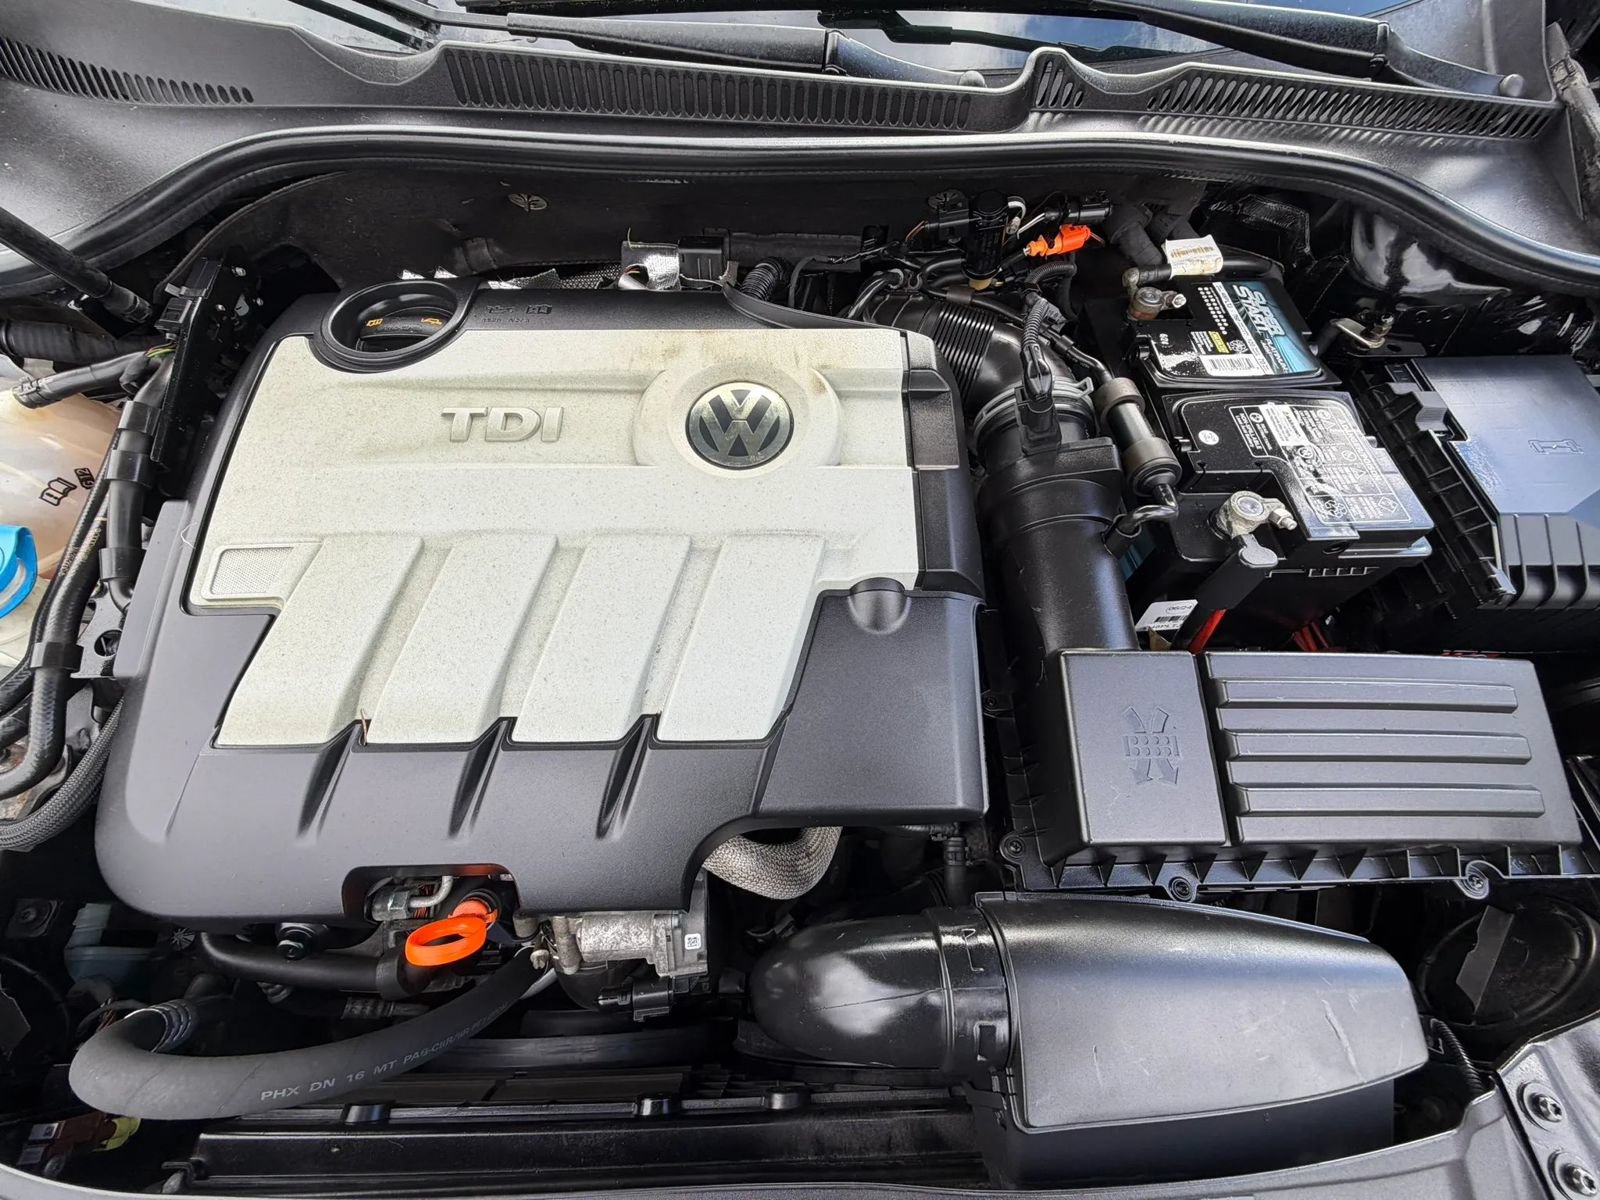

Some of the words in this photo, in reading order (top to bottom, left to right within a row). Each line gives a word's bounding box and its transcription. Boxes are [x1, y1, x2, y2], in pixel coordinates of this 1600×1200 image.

[1232, 285, 1267, 337] START
[1252, 290, 1286, 337] SUPER
[440, 406, 564, 443] TDI
[685, 380, 795, 471] VW
[261, 1086, 300, 1101] PHX
[309, 1078, 336, 1092] DN
[346, 1070, 366, 1083] 16
[373, 1060, 398, 1075] MT
